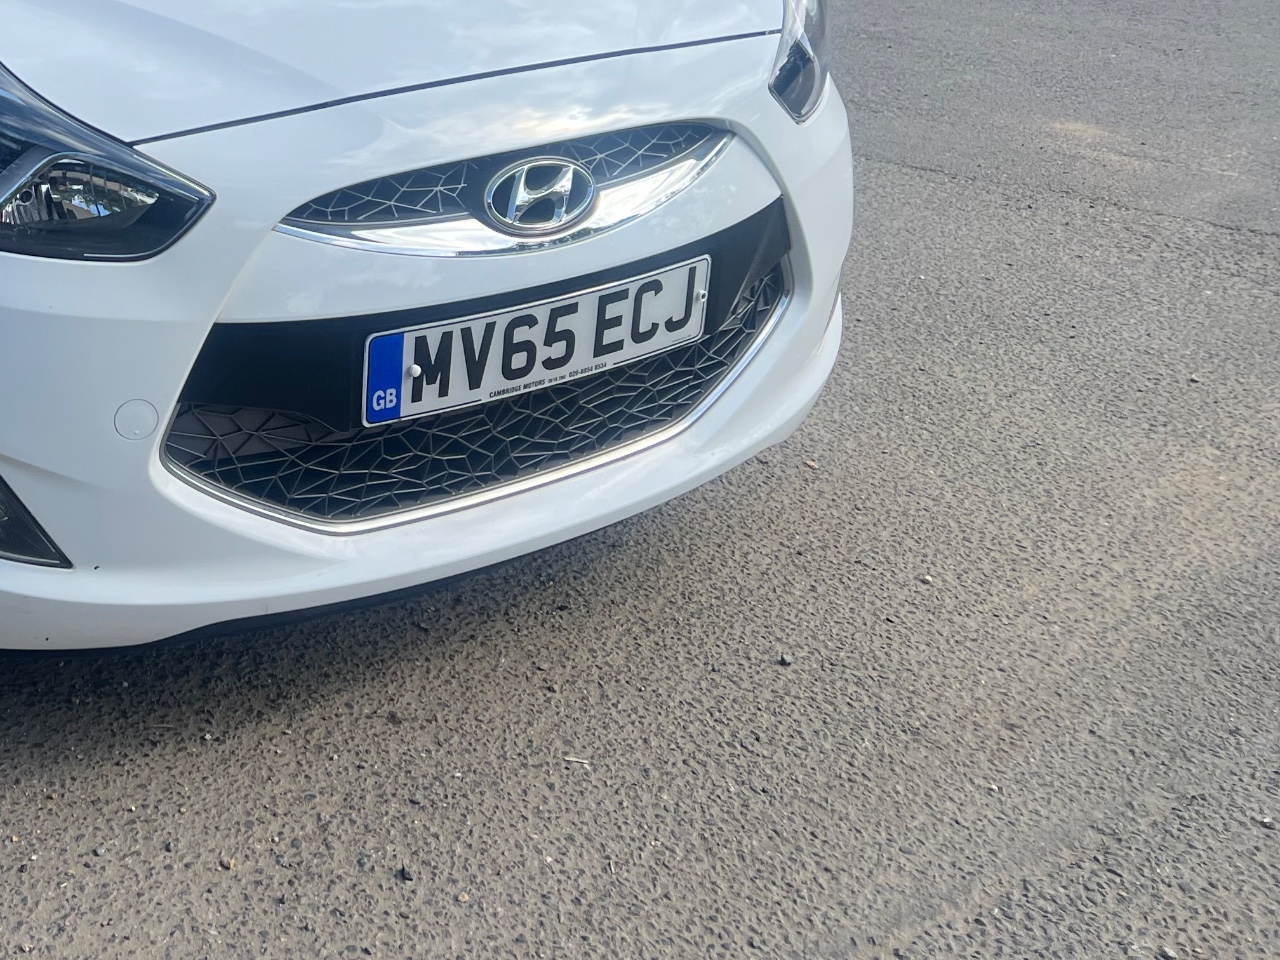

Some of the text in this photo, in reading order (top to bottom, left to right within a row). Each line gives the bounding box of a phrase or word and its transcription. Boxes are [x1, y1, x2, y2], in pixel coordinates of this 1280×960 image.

[411, 266, 697, 403] MV65 ECJ
[372, 388, 397, 411] GB
[489, 384, 522, 398] CAMBRIDGE
[523, 378, 546, 390] MOTORS
